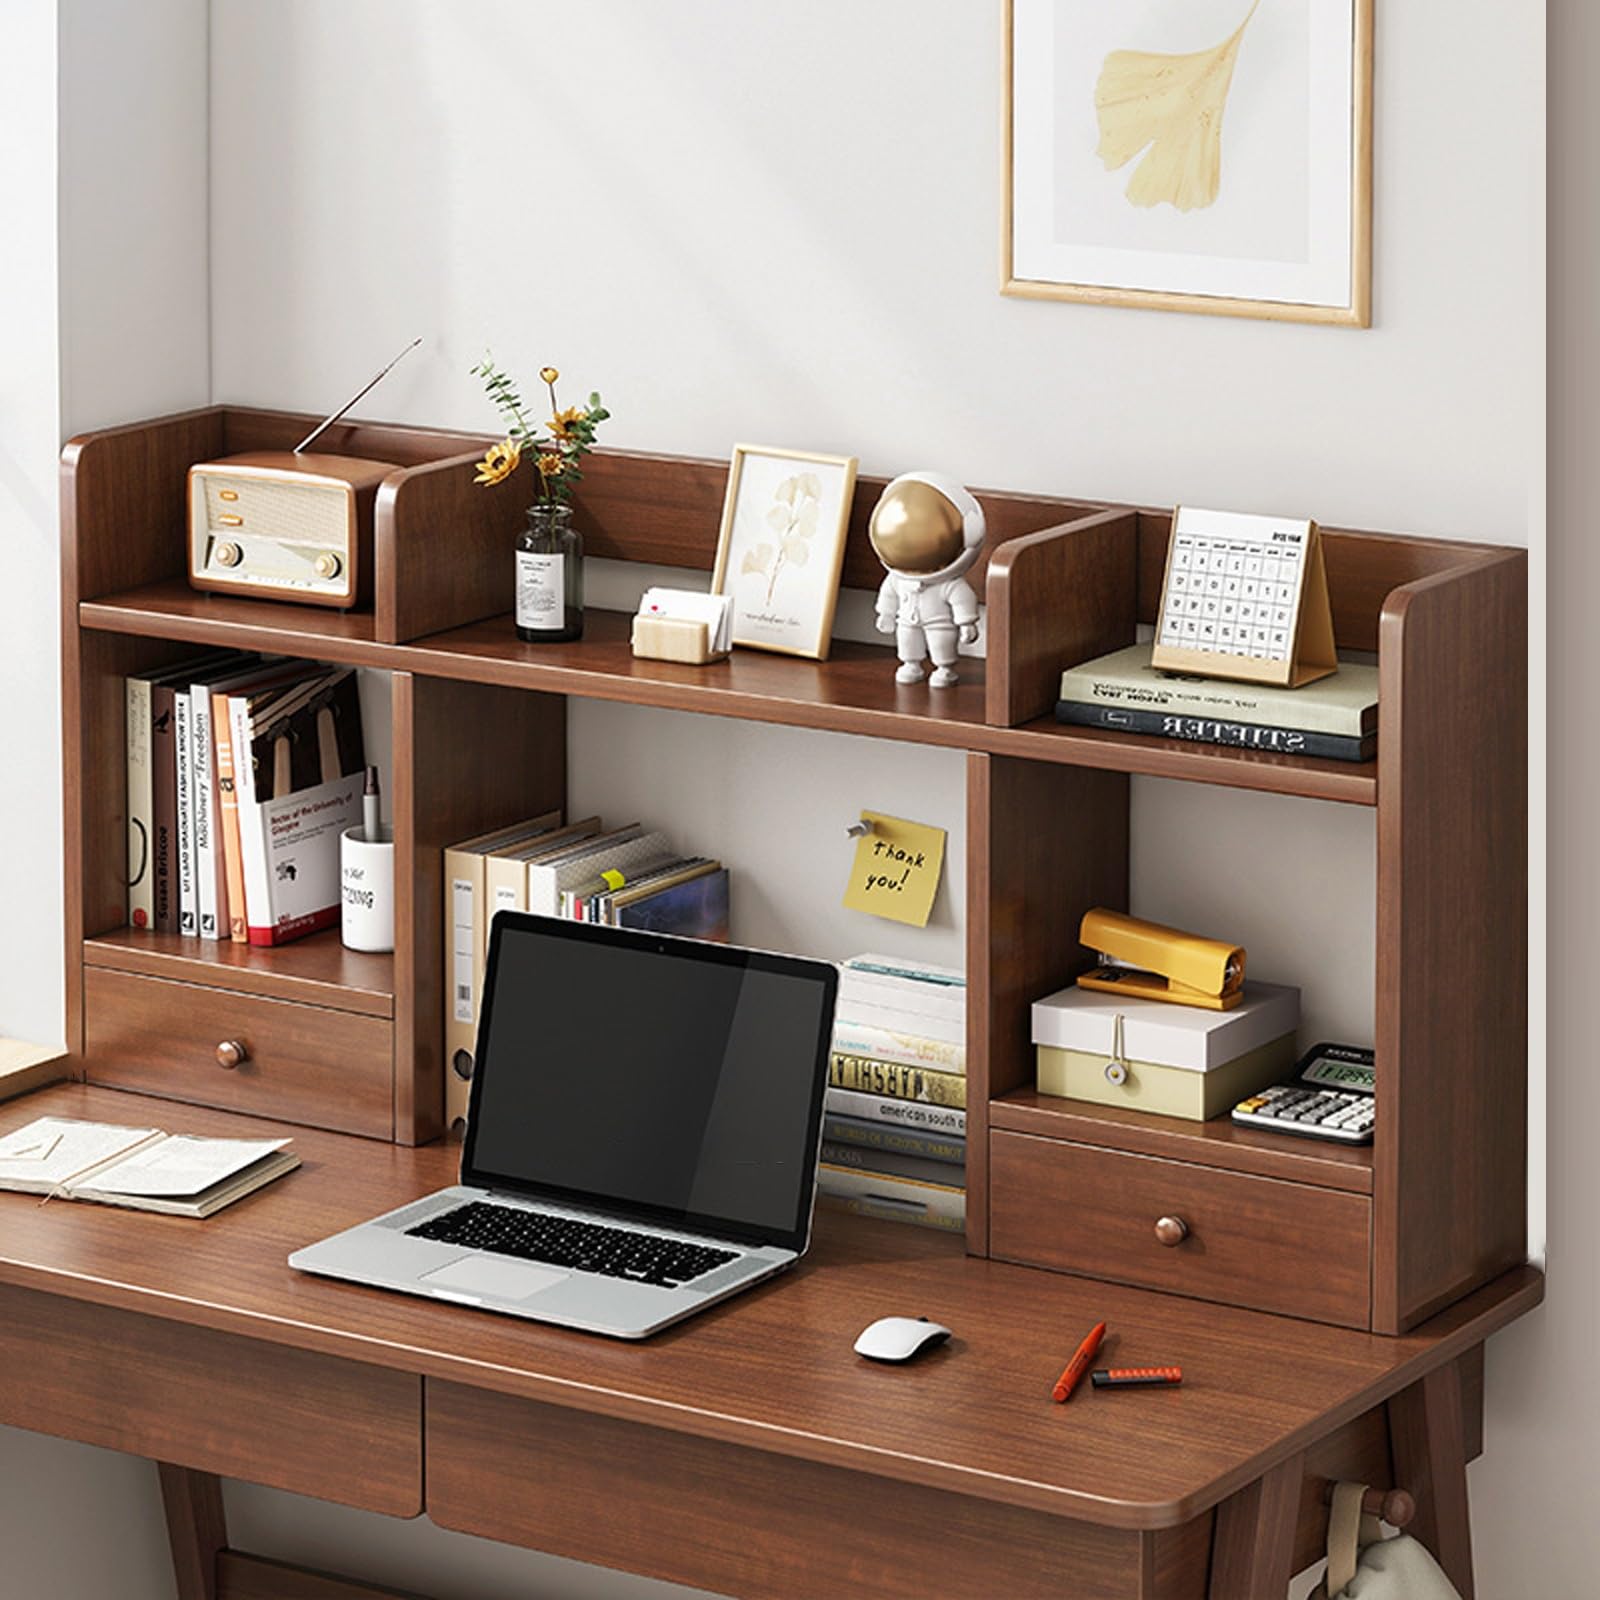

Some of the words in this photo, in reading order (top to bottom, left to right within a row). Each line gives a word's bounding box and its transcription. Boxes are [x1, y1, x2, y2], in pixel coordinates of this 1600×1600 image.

[159, 826, 168, 876] Briscoe
[865, 869, 910, 891] you!
[158, 880, 169, 920] Susan
[880, 1104, 926, 1121] american
[928, 1114, 957, 1127] south
